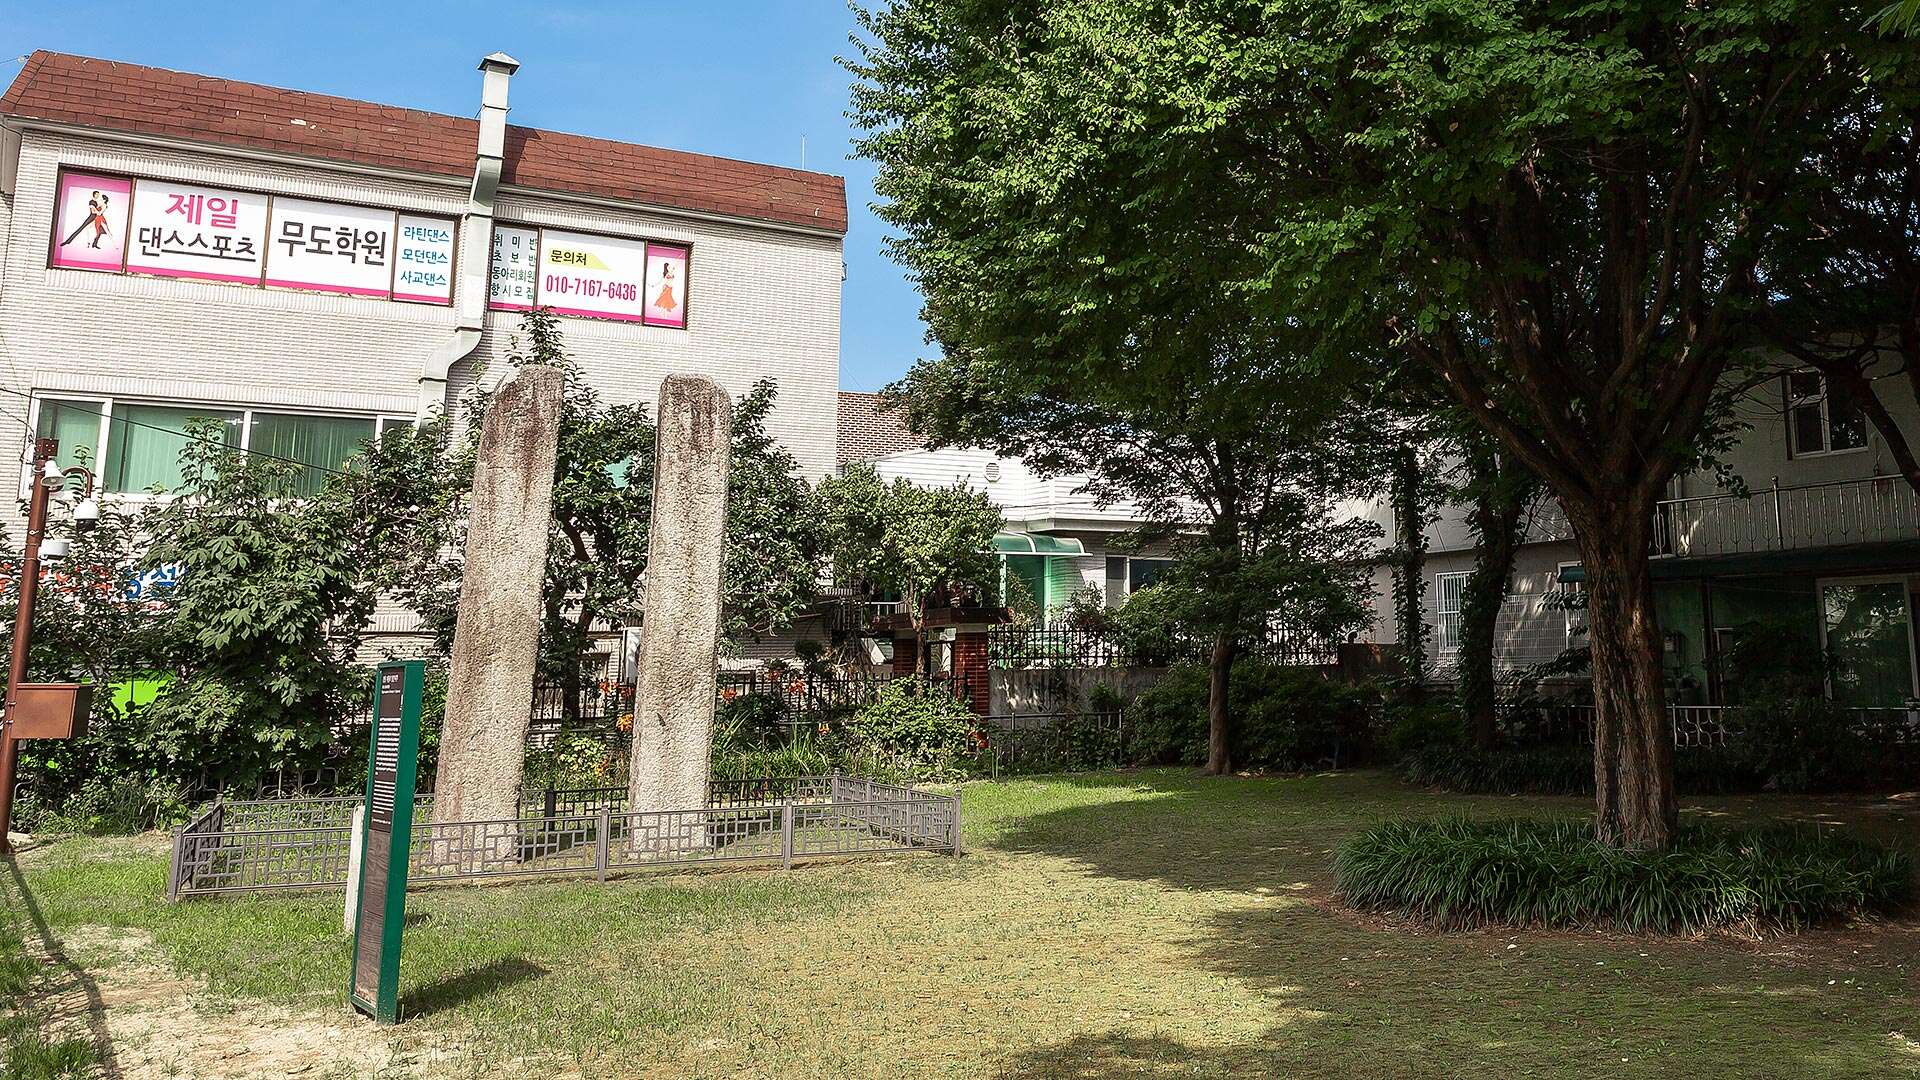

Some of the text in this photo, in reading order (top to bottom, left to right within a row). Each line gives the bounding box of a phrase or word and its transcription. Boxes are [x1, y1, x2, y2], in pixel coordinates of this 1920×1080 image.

[165, 193, 239, 230] 제일
[138, 226, 257, 263] 댄스스포츠
[277, 220, 387, 267] 무도학원
[403, 225, 450, 243] 라틴댄스
[401, 248, 448, 265] 모던댄스
[551, 249, 587, 266] 문의처
[400, 270, 447, 287] 사교댄스
[545, 274, 637, 302] 010-7167-6436
